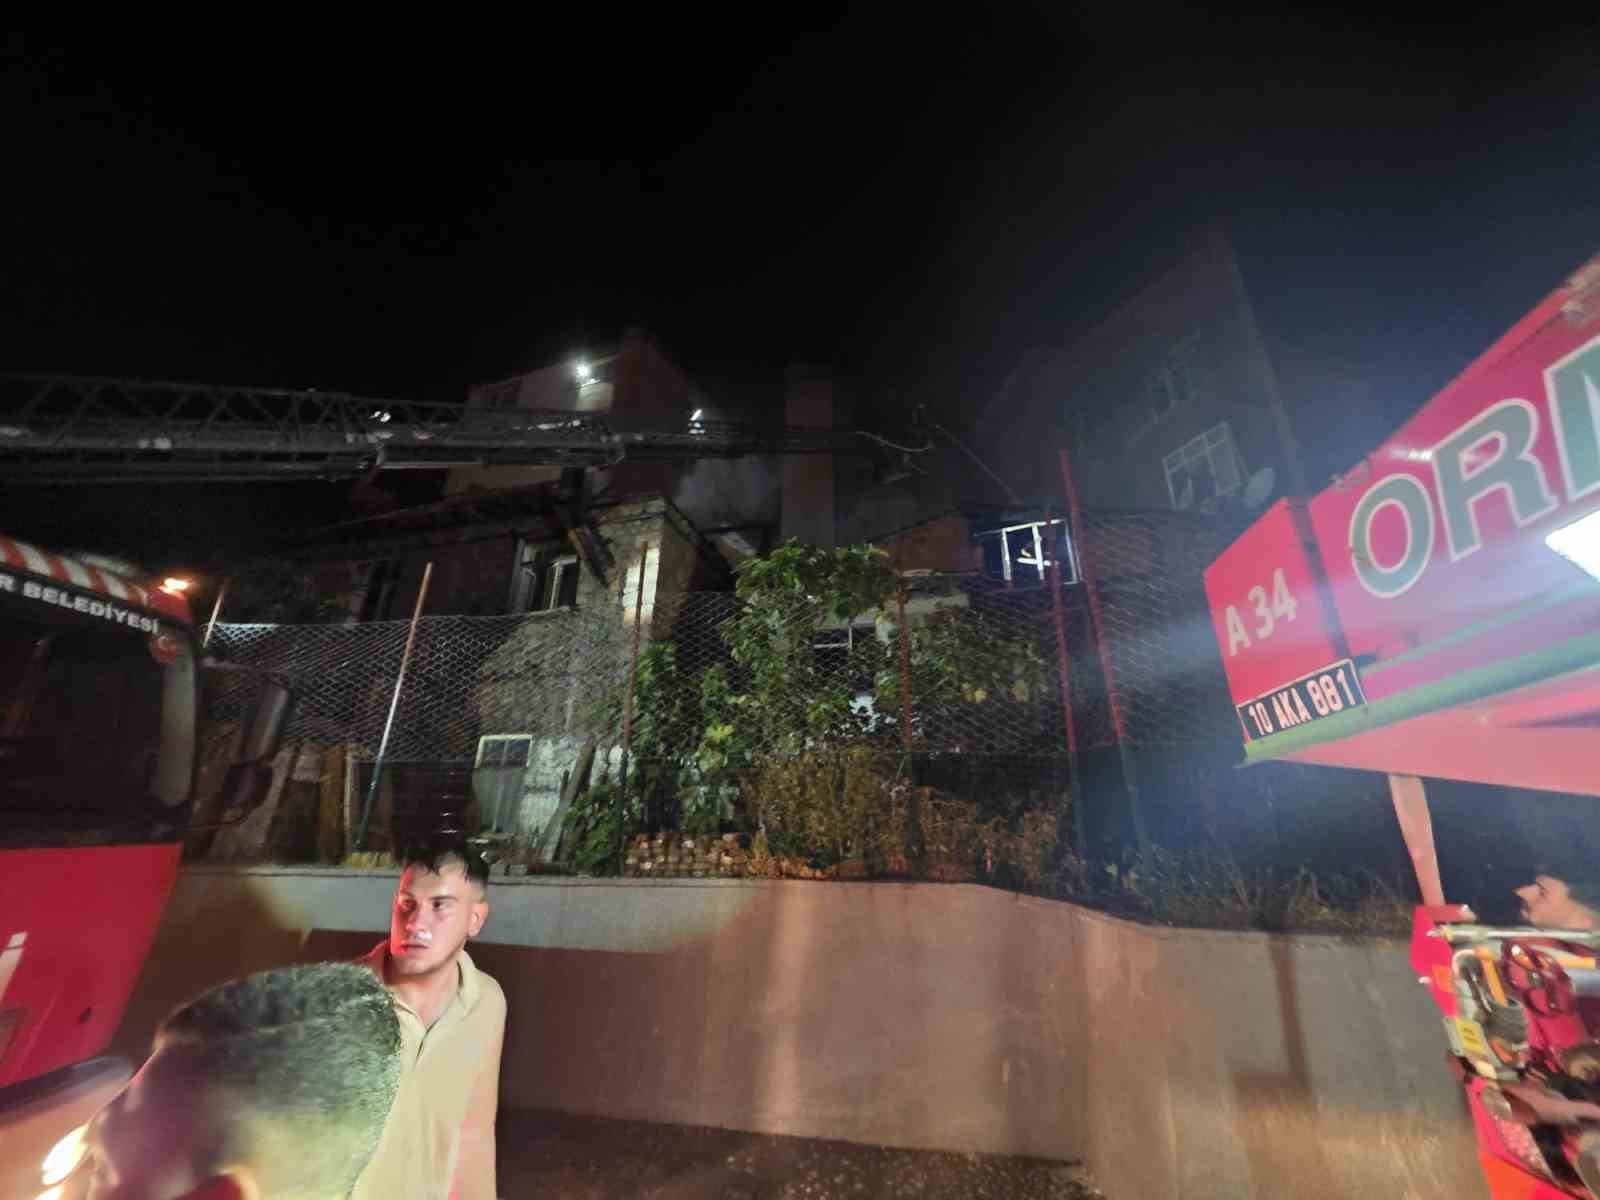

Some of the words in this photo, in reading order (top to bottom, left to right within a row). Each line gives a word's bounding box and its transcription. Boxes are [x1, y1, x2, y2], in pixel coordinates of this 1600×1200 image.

[23, 580, 160, 634] BELEDİYESİ
[1225, 604, 1252, 657] A
[1247, 567, 1297, 640] 34
[1248, 702, 1274, 736] 10
[1271, 687, 1312, 729] AKA
